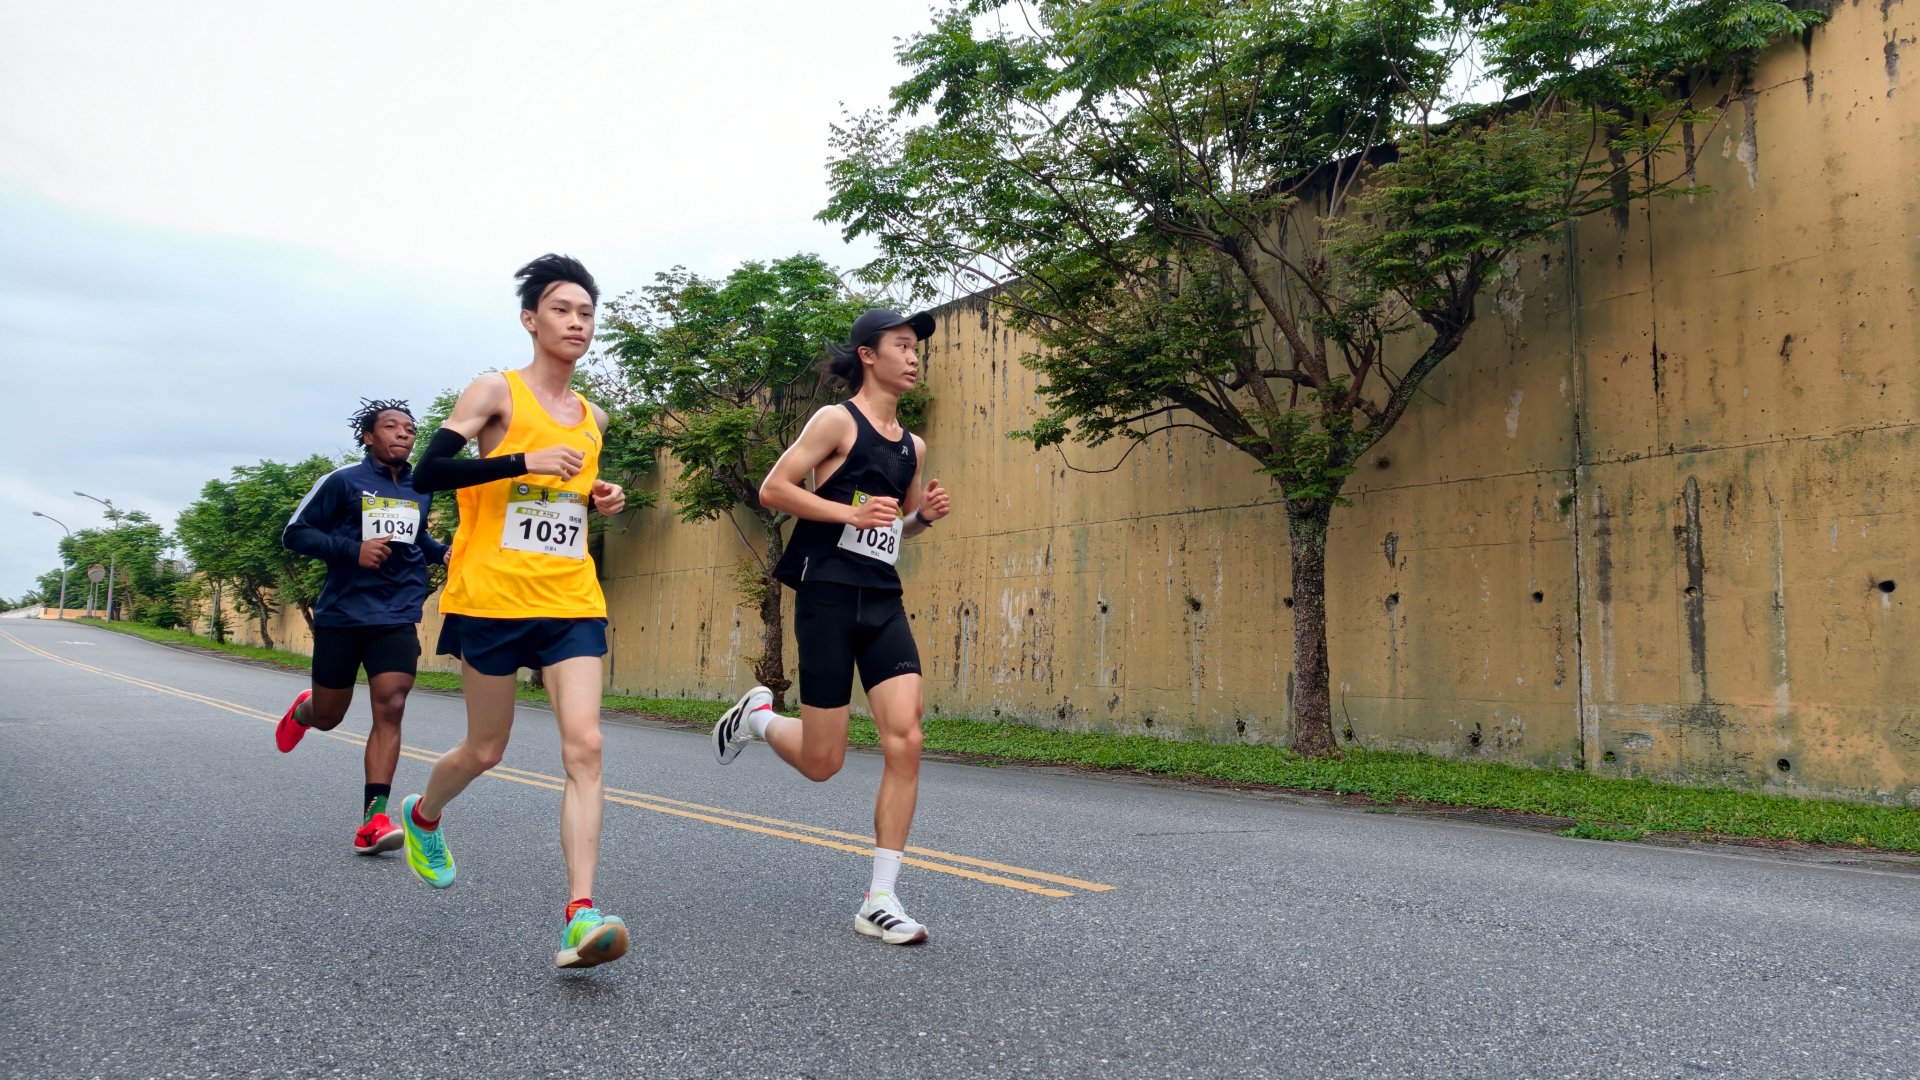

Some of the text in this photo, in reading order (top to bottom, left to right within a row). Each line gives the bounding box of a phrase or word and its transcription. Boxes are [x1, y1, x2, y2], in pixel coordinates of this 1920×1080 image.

[372, 519, 414, 537] 1034
[519, 518, 579, 547] 1037
[856, 527, 895, 554] 1028
